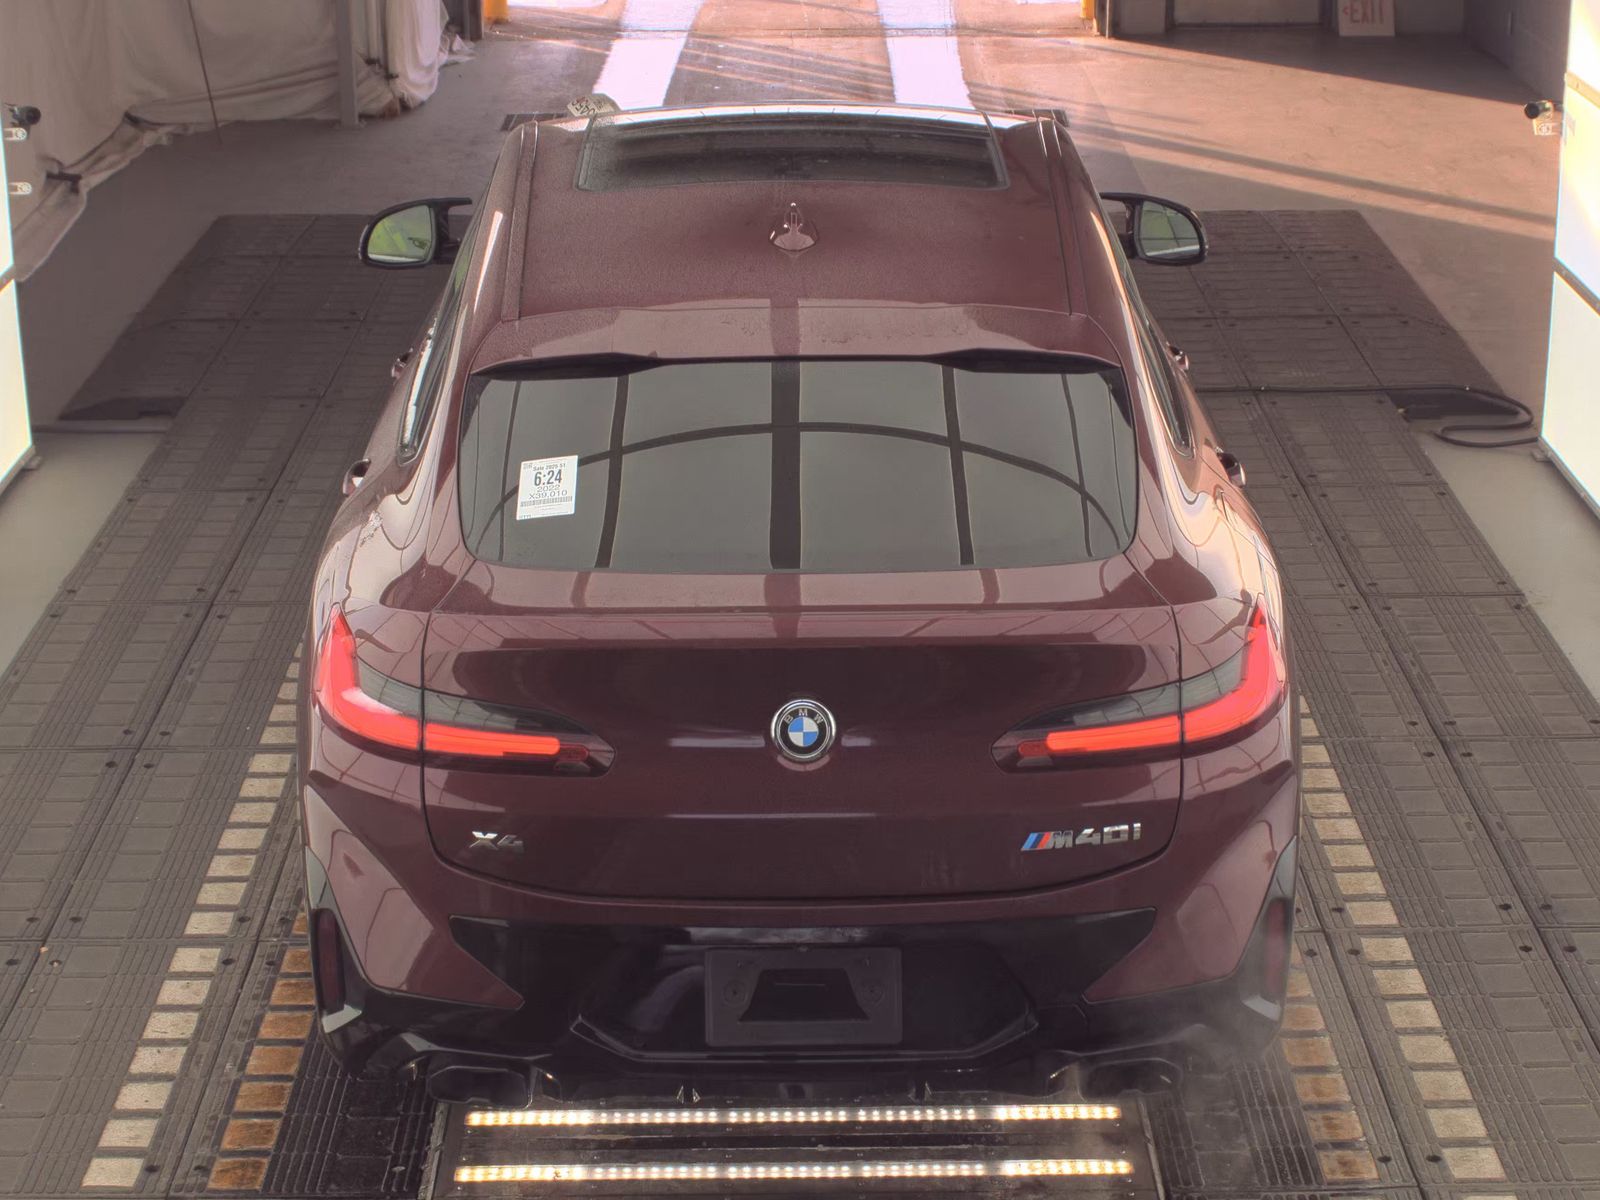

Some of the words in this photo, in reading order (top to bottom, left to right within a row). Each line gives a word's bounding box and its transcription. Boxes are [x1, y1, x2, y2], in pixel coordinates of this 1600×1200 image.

[534, 469, 562, 486] 6:24
[537, 484, 561, 493] 2022
[784, 708, 823, 724] BMW
[469, 831, 524, 853] X4
